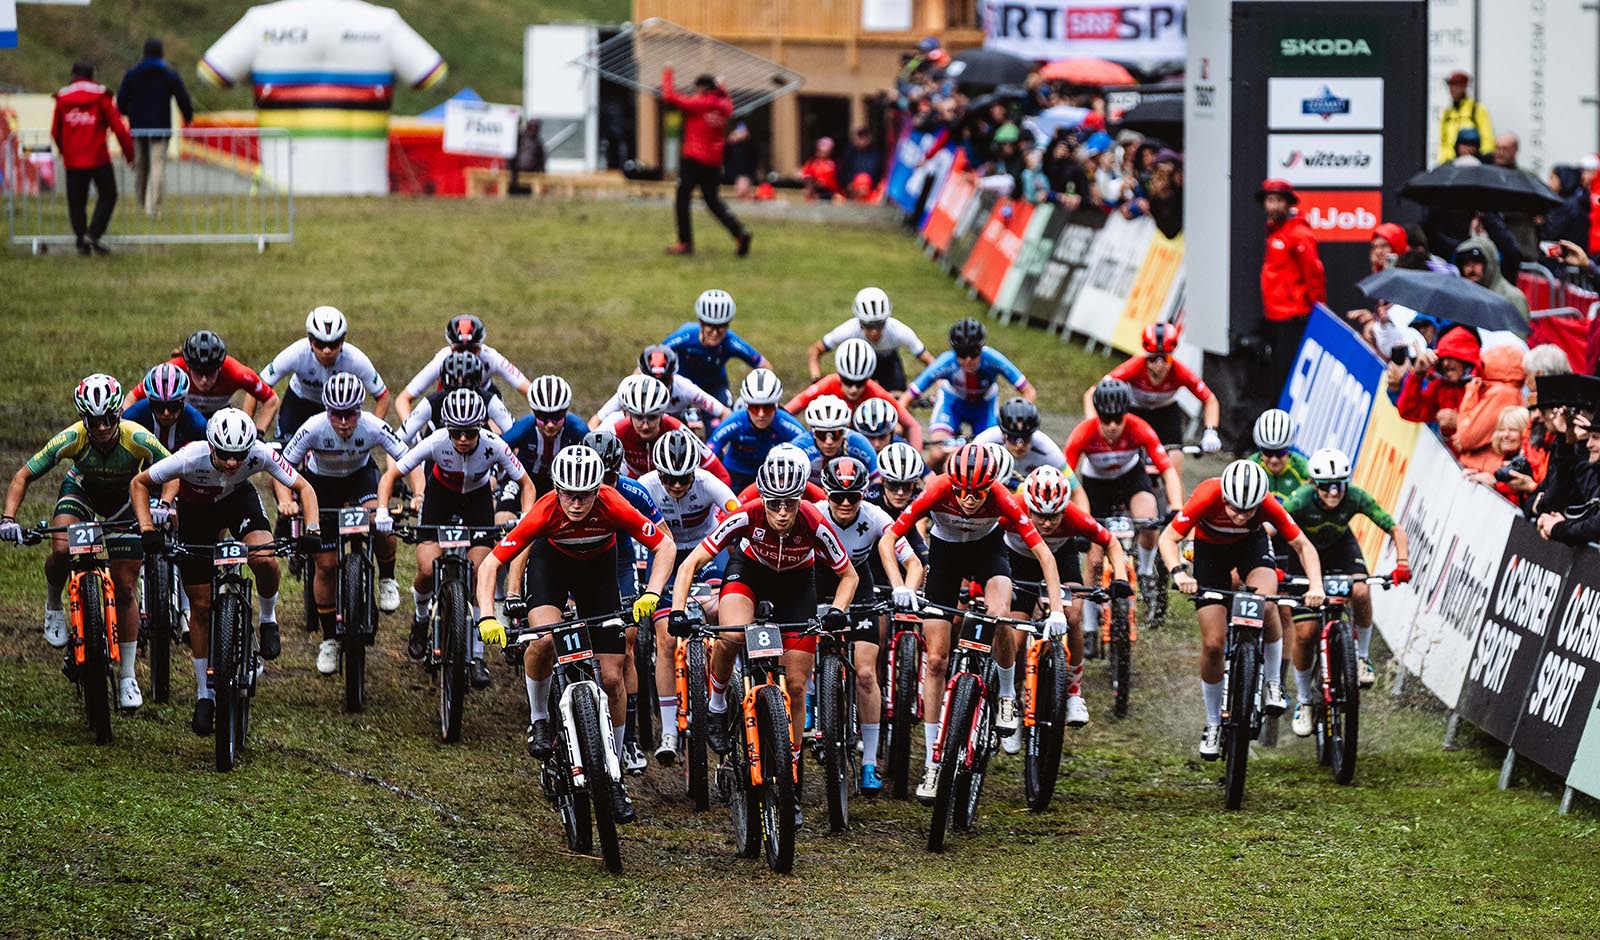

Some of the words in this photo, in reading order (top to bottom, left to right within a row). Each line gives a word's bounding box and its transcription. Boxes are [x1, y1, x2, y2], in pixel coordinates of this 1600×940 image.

[1071, 13, 1116, 34] SRF
[1120, 6, 1186, 39] SP
[1304, 151, 1372, 168] vittoria
[1305, 206, 1377, 230] lJob
[344, 512, 365, 526] 27
[75, 528, 95, 544] 21
[445, 529, 463, 542] 17
[221, 545, 241, 558] 18
[1327, 580, 1350, 597] 34
[1438, 544, 1492, 641] vittoria
[1494, 554, 1562, 637] OCHSNER
[1239, 601, 1258, 618] 12
[758, 630, 771, 647] 8
[974, 623, 984, 641] 1
[562, 631, 581, 652] 11
[1468, 618, 1523, 695] SPORT
[1527, 650, 1587, 728] SPORT
